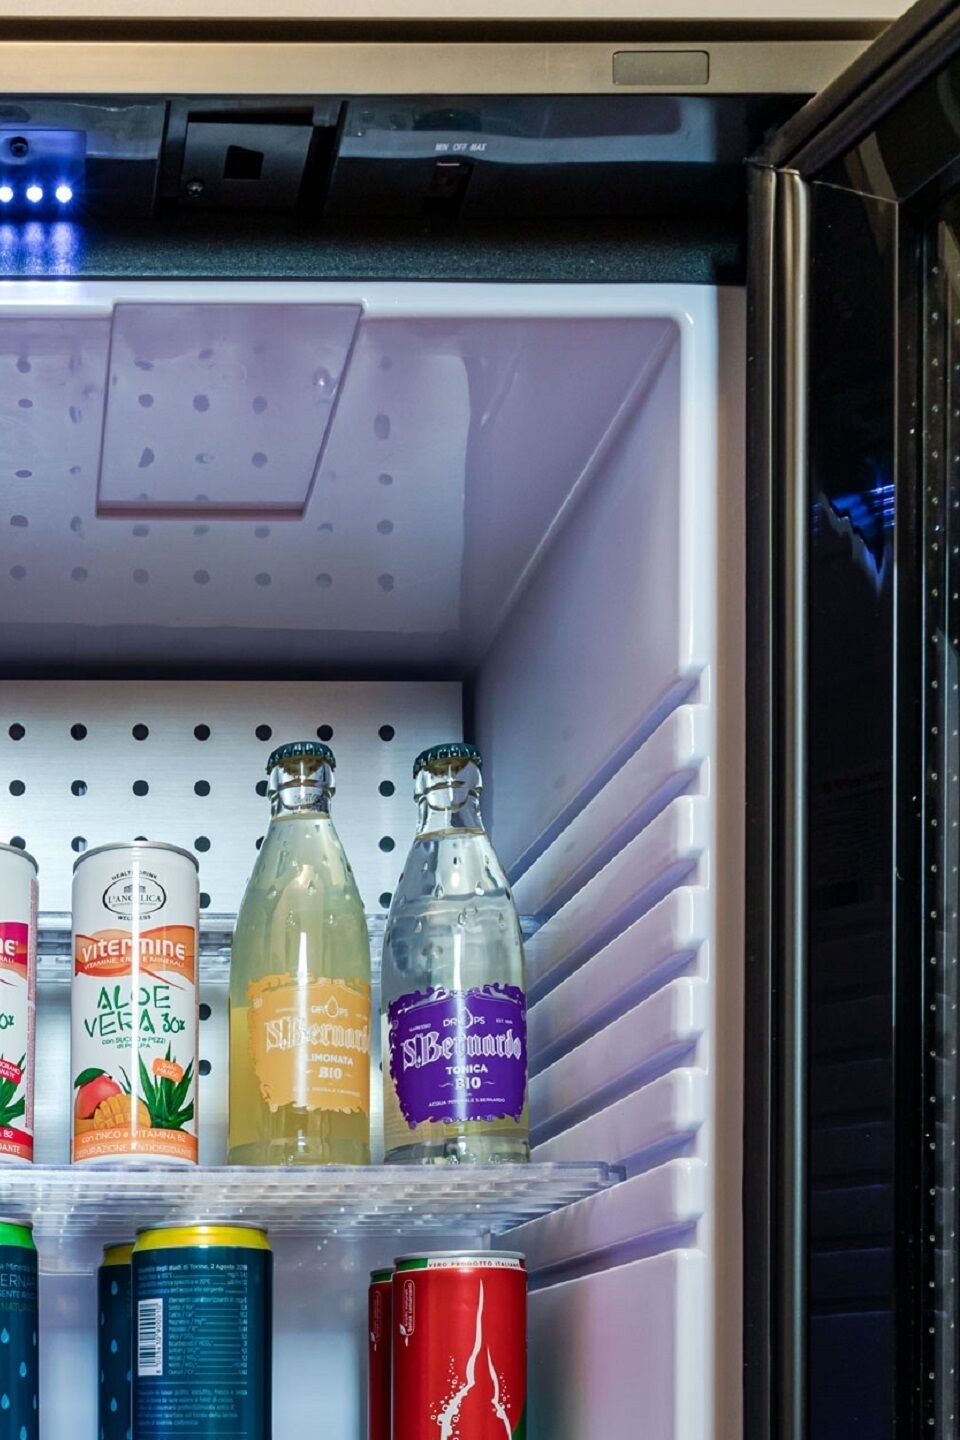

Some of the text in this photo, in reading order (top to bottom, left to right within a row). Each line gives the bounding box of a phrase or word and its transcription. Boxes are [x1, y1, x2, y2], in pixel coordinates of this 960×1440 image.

[452, 143, 467, 151] OFF
[108, 894, 162, 903] L'ANGLICA
[97, 985, 171, 1010] ALOE
[84, 1009, 155, 1037] VERA
[401, 1028, 521, 1072] S.Bernardo
[318, 1067, 342, 1078] BIO
[446, 1064, 488, 1075] TONICA
[455, 1077, 481, 1090] BIO
[3, 1128, 13, 1138] B2
[95, 1131, 120, 1140] ZINCO
